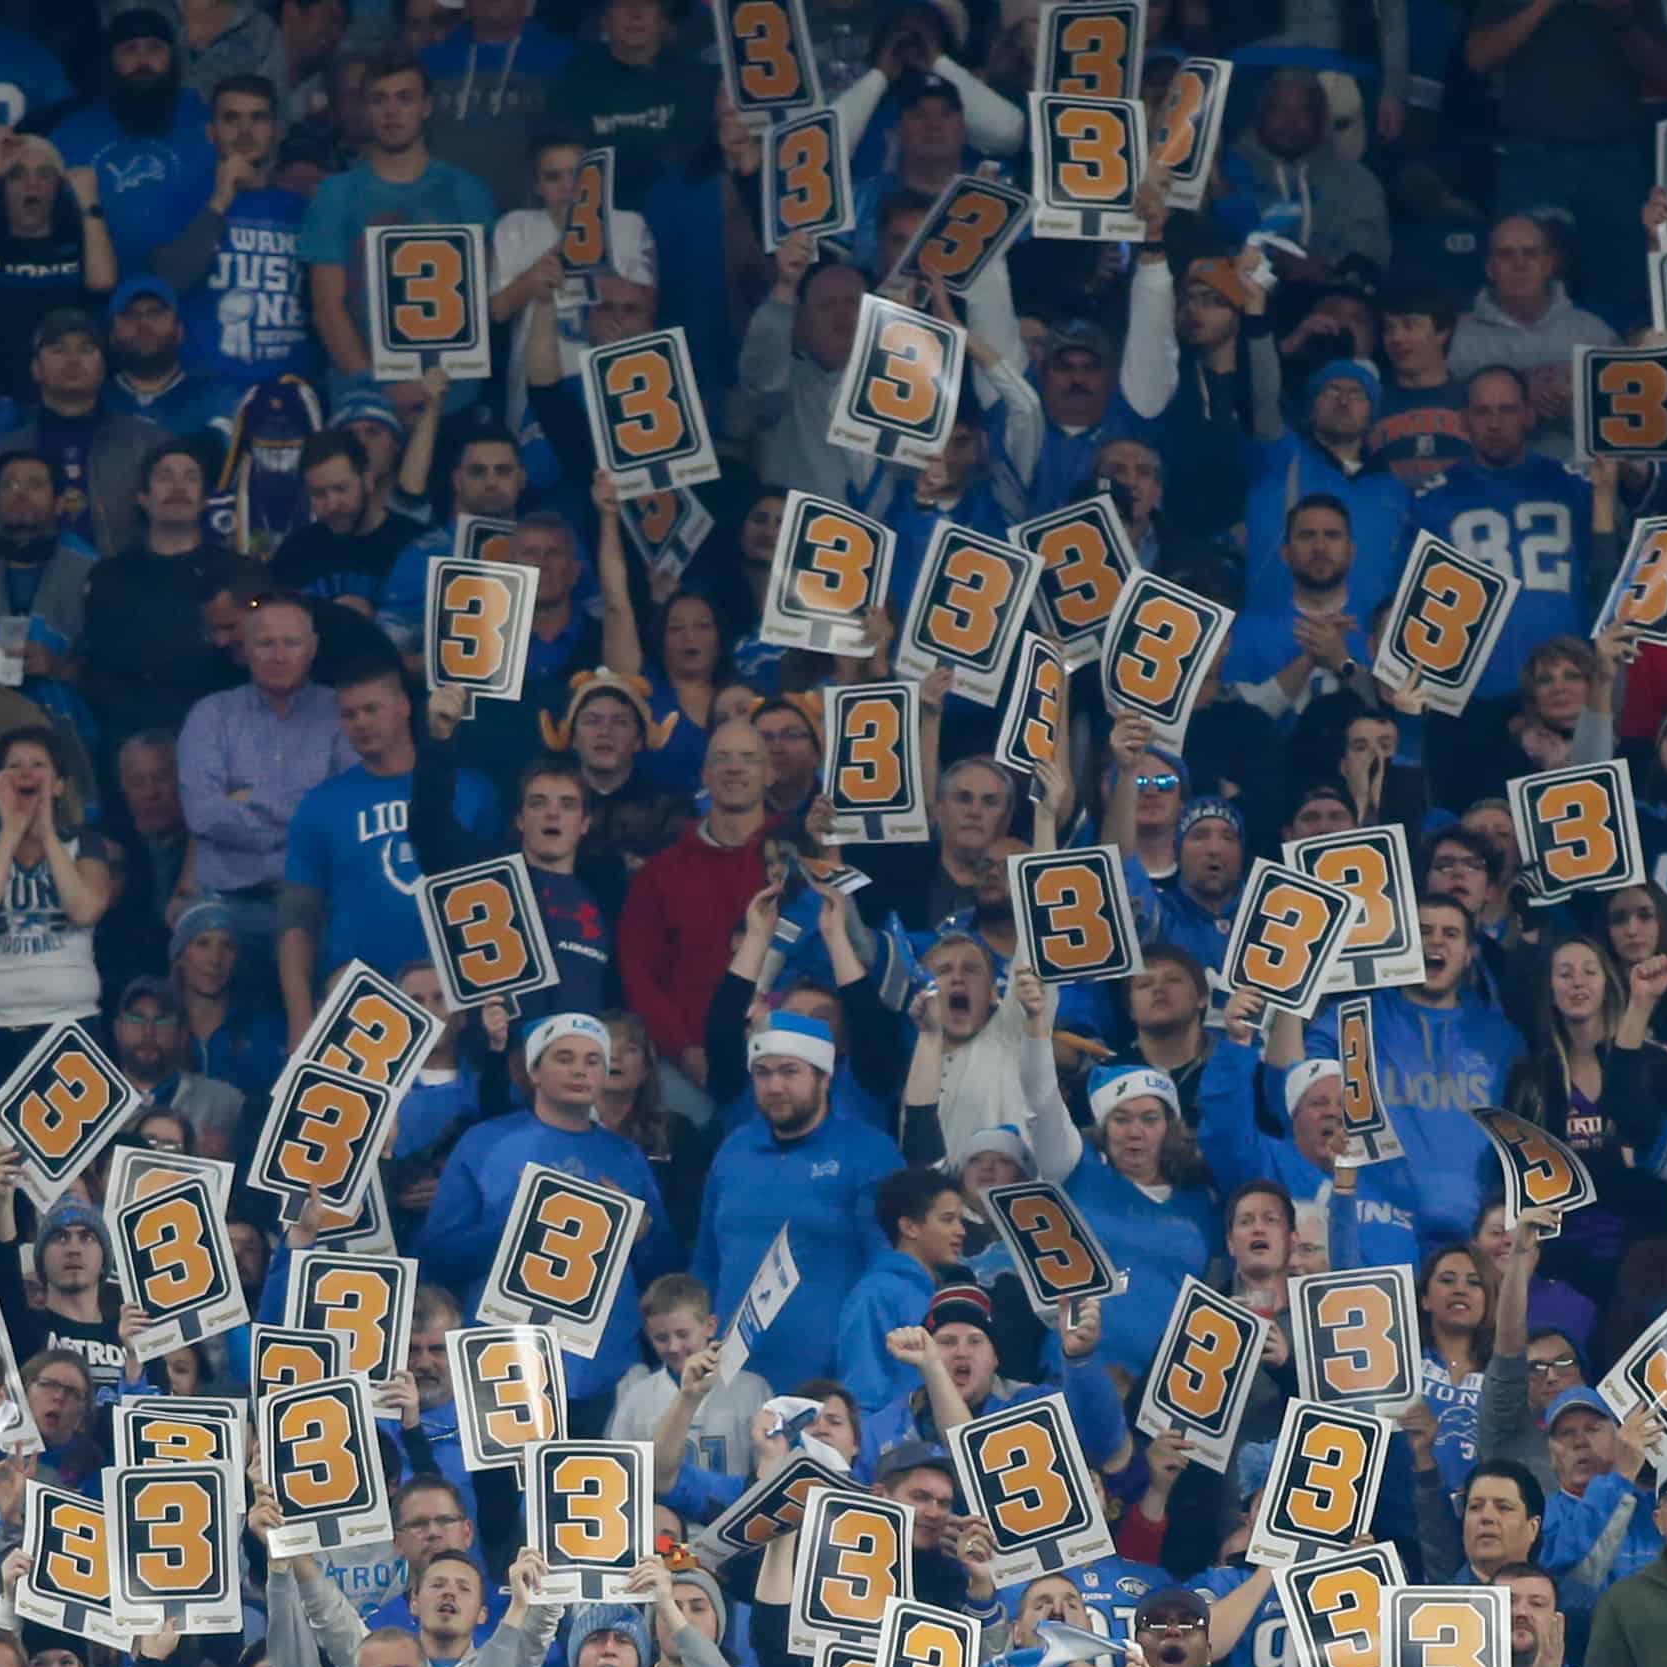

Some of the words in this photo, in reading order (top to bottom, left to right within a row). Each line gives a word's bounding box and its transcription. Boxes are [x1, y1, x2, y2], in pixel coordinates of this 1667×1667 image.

[735, 3, 799, 98] 3
[1057, 109, 1127, 199] 3
[394, 243, 464, 339] 3
[607, 353, 683, 455] 3
[800, 516, 874, 611] 3
[1450, 501, 1573, 593] 82
[929, 550, 1012, 654] 3
[1117, 599, 1200, 704] 3
[1403, 564, 1486, 670] 3
[840, 701, 900, 802] 3
[357, 799, 412, 843] LIO
[1538, 782, 1616, 881] 3
[445, 882, 527, 984] 3
[1035, 867, 1112, 968] 3
[1243, 888, 1329, 990] 3
[20, 1053, 109, 1157] 3
[279, 1084, 370, 1187] 3
[1384, 1069, 1492, 1111] LIONS
[134, 1200, 214, 1307] 3
[522, 1194, 611, 1304] 3
[1167, 1308, 1241, 1417] 3
[1319, 1289, 1399, 1392] 3
[1421, 1379, 1481, 1407] ION
[280, 1398, 358, 1507] 3
[981, 1422, 1071, 1535] 3
[1287, 1423, 1366, 1534] 3
[47, 1505, 112, 1599] 3
[135, 1483, 212, 1589] 3
[554, 1458, 627, 1560] 3
[821, 1511, 897, 1620] 3
